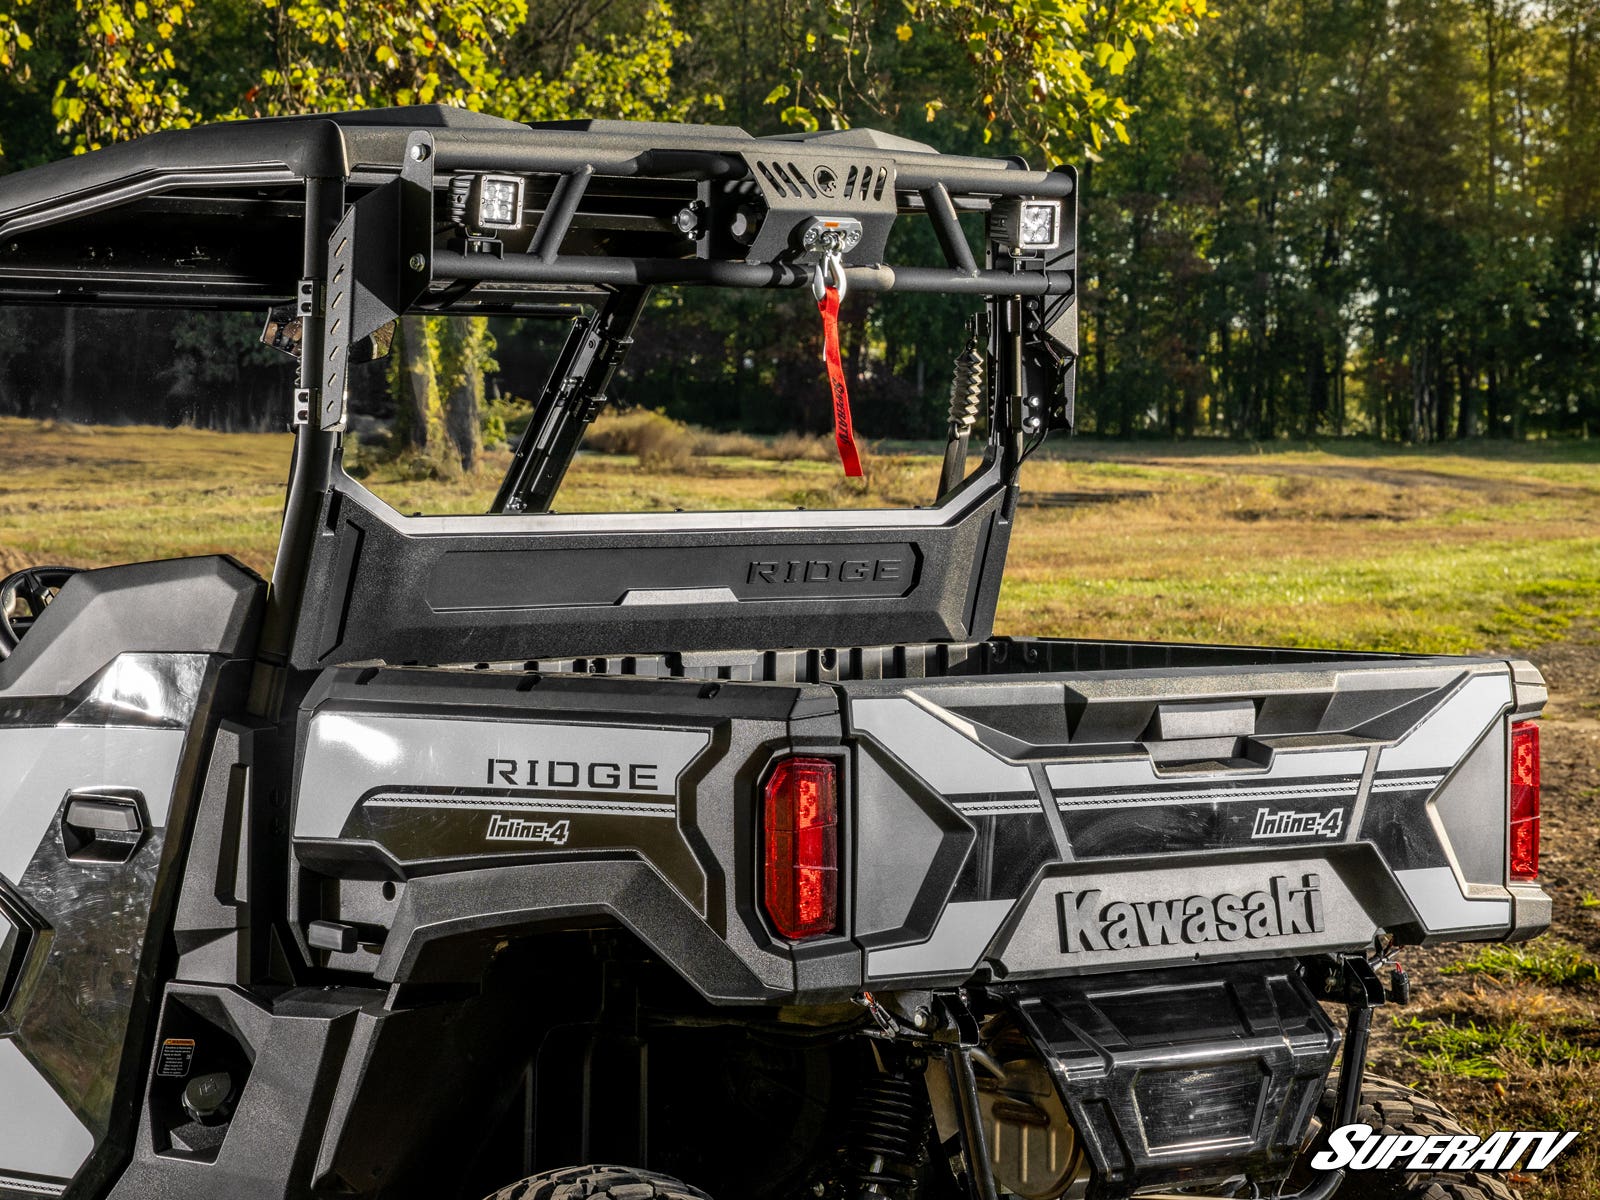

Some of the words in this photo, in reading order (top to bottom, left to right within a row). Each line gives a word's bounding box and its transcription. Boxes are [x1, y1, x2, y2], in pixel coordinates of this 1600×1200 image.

[746, 560, 902, 584] RIDGE
[487, 758, 658, 790] RIDGE
[486, 815, 570, 845] Inline-4
[1251, 807, 1344, 839] Inline-4
[1055, 873, 1325, 953] Kawasaki
